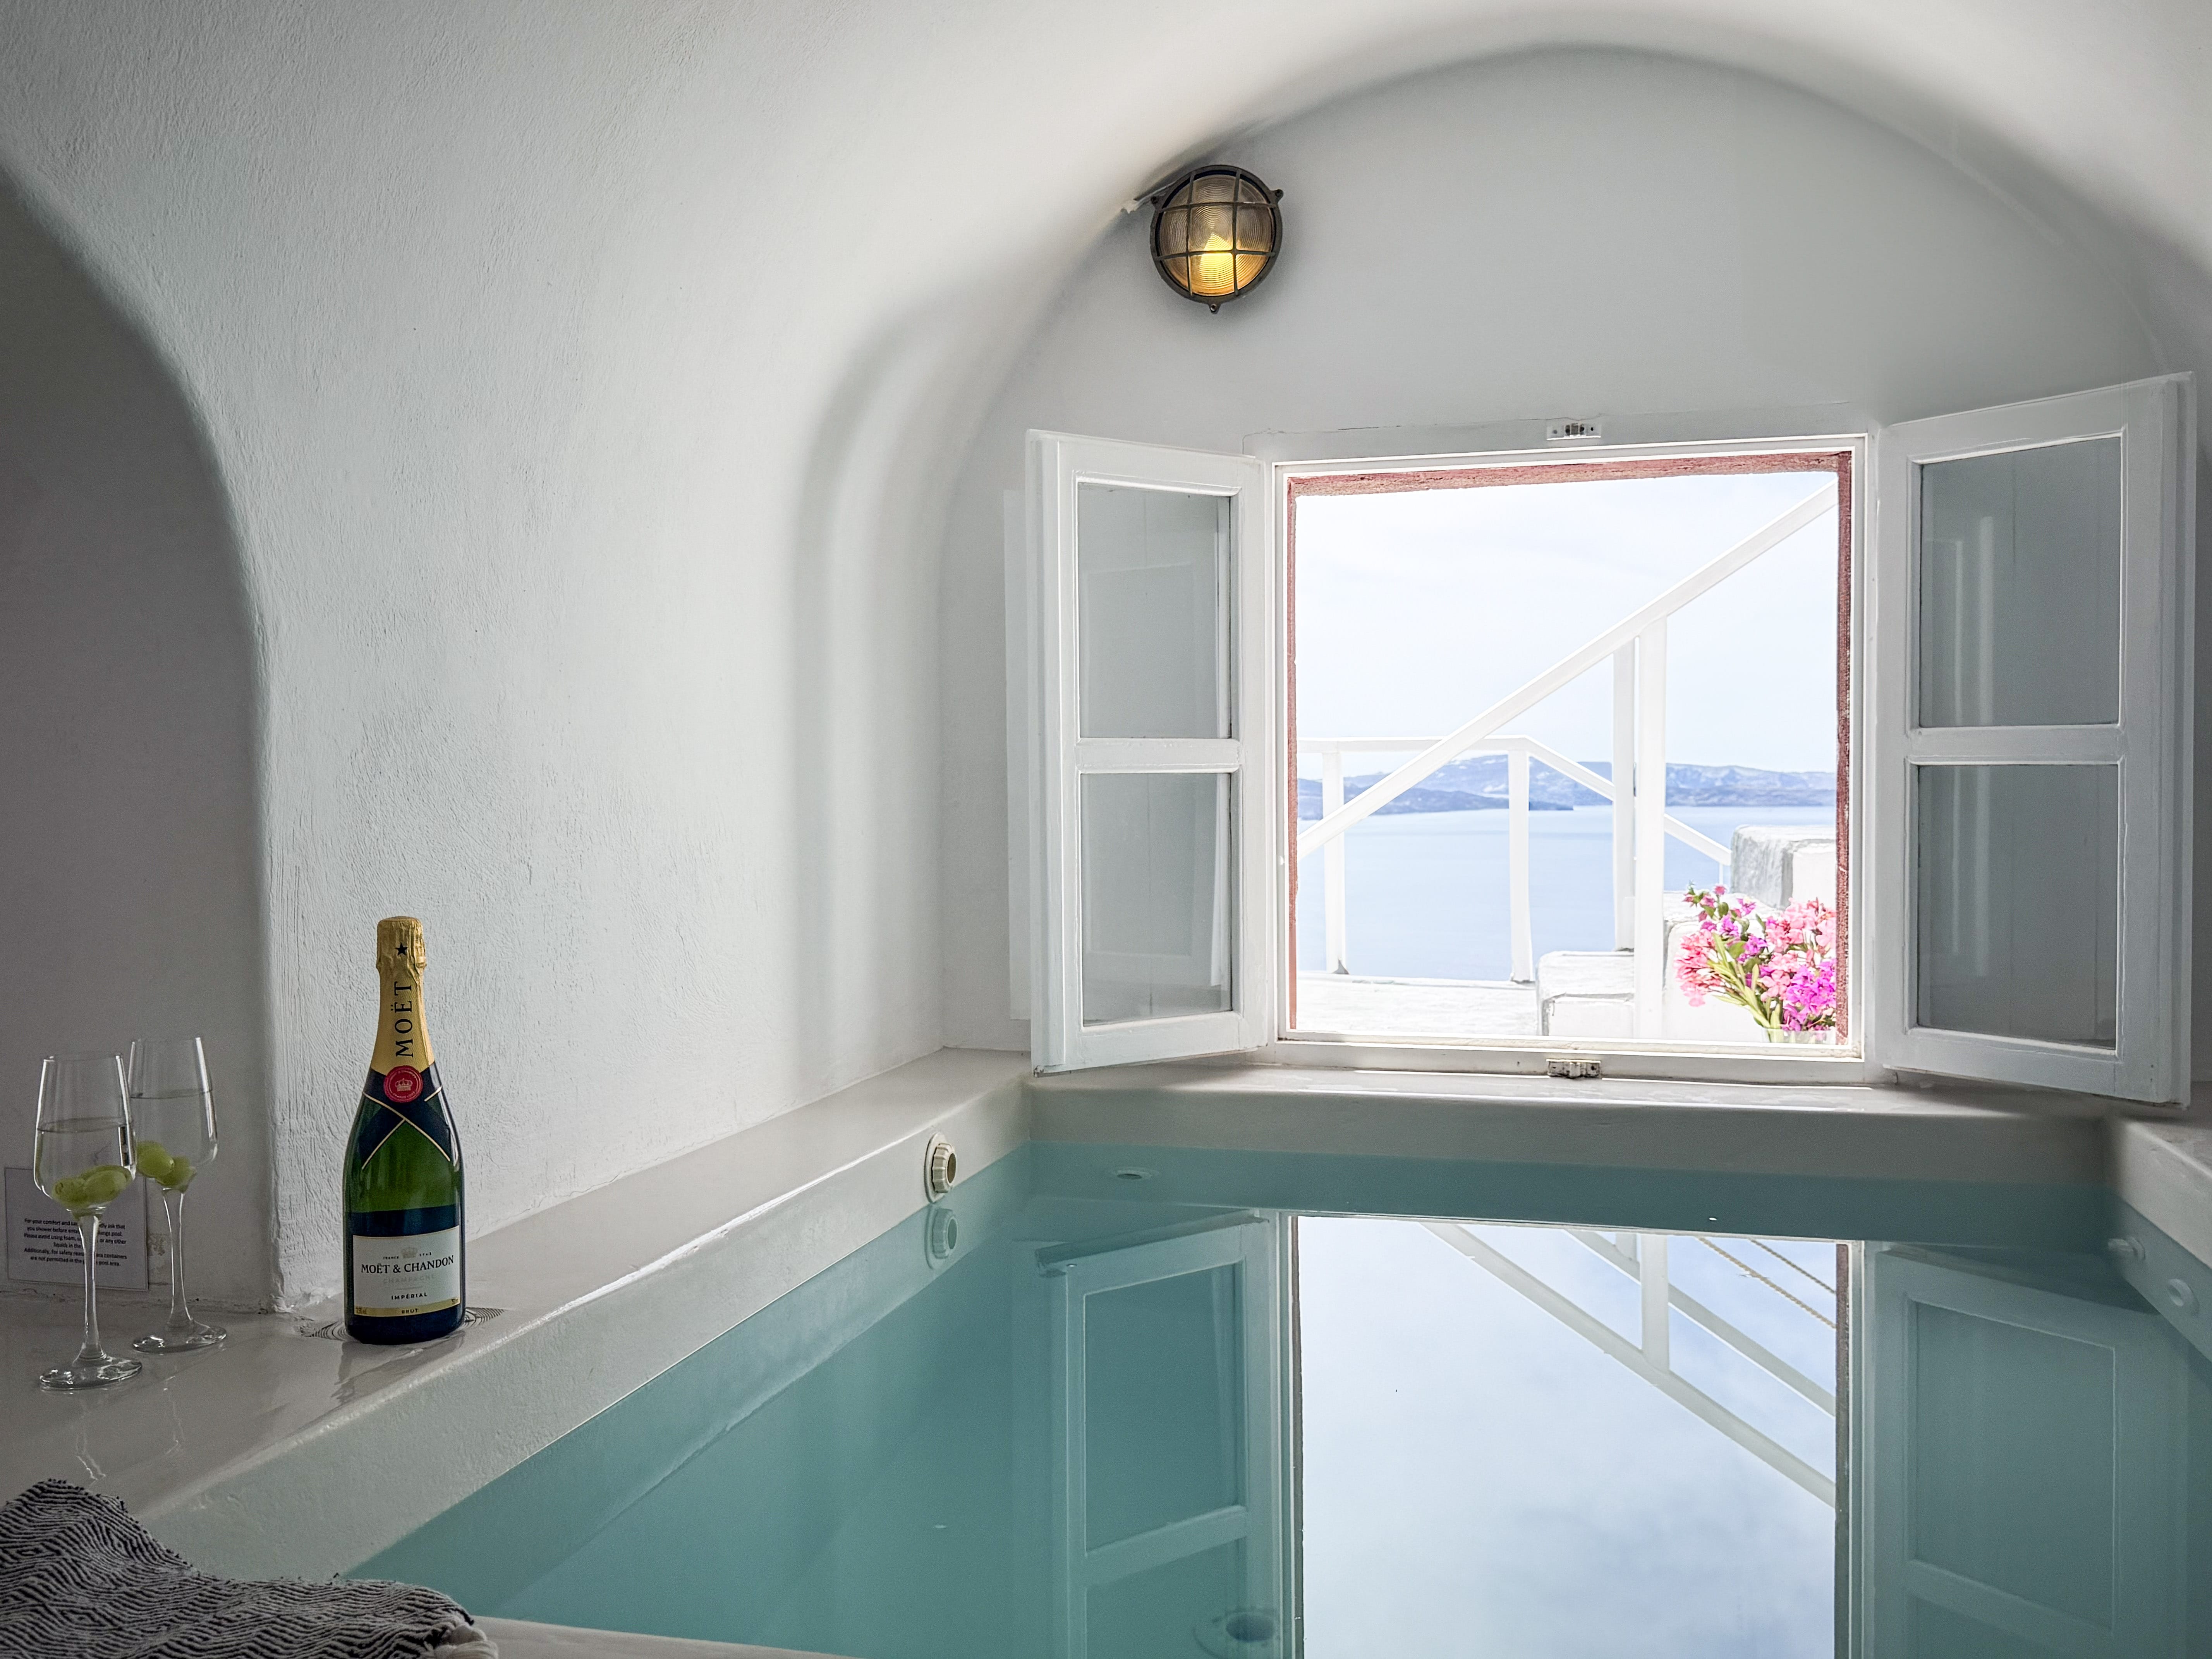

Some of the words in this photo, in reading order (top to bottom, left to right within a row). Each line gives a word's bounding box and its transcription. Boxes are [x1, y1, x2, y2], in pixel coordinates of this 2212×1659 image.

[390, 981, 414, 1058] MOËT
[361, 1263, 390, 1274] MOËT
[393, 1264, 401, 1273] &
[404, 1255, 454, 1273] CHANDON
